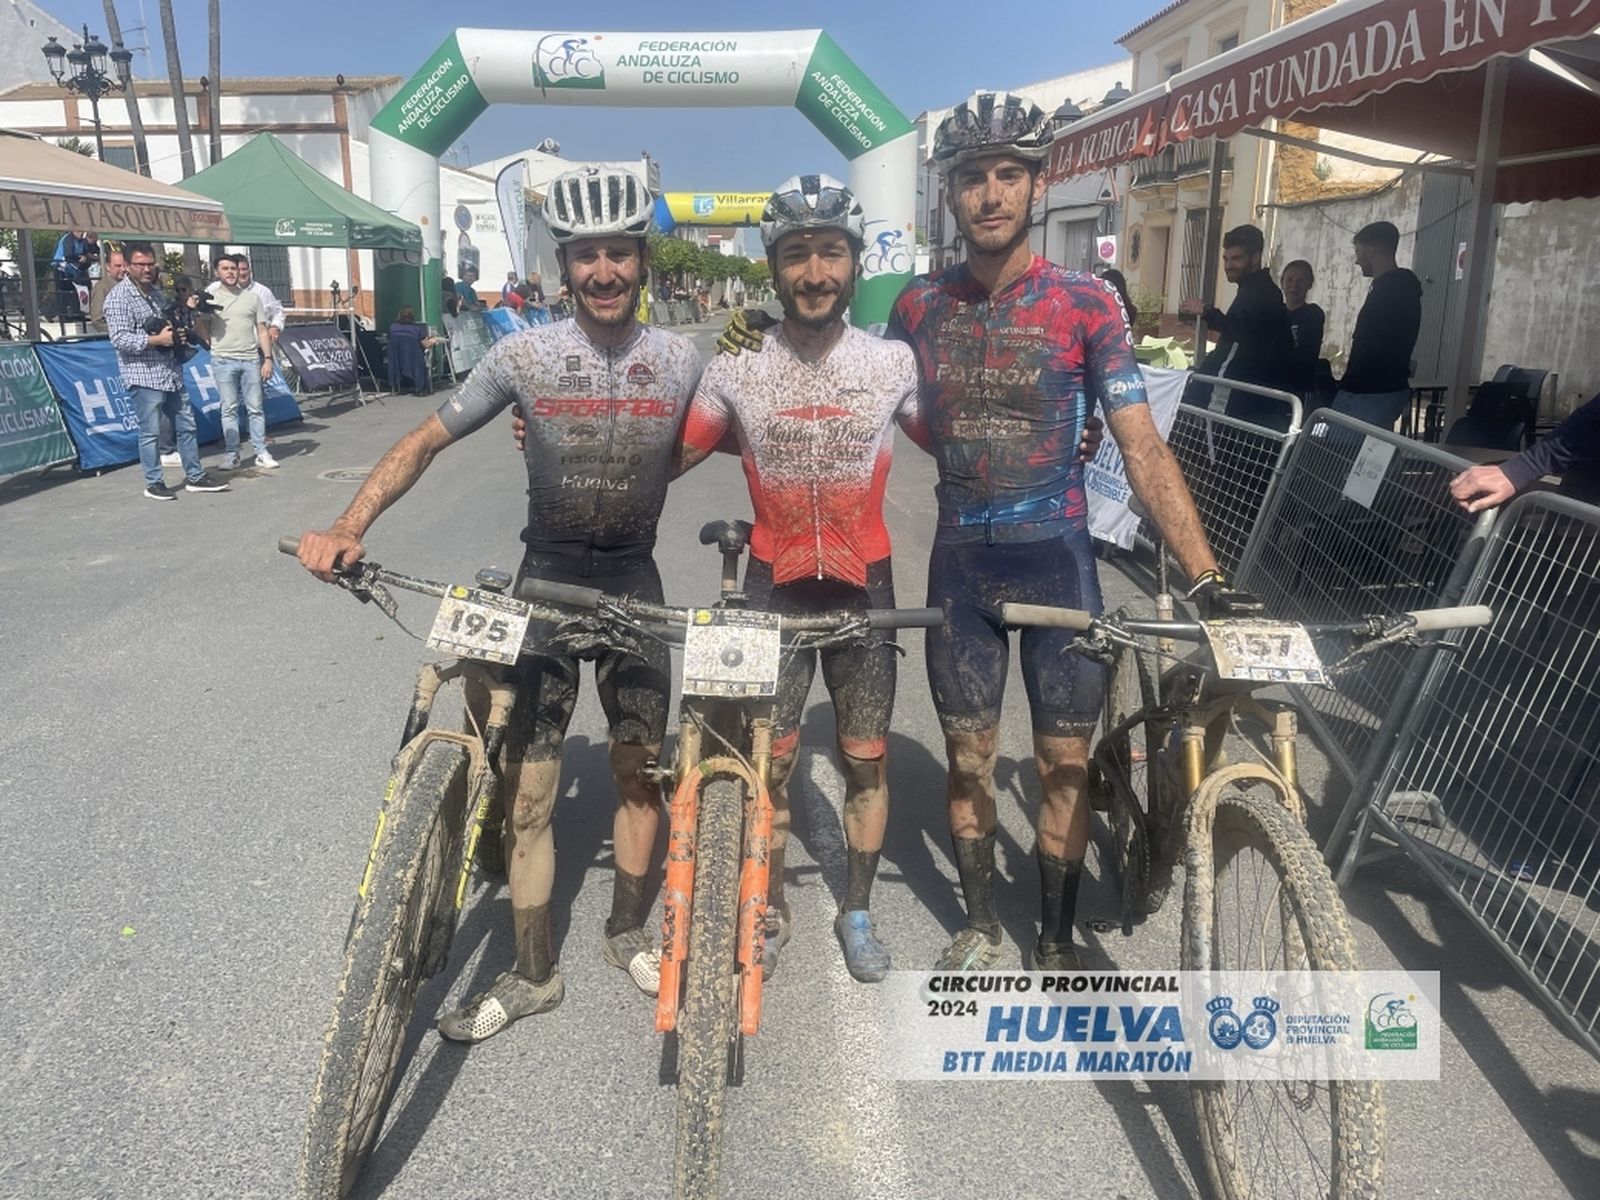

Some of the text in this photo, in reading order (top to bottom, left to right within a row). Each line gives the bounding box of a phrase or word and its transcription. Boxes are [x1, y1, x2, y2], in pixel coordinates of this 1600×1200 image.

[616, 54, 702, 67] ANDALUZA
[638, 40, 738, 52] FEDERACIÓN
[643, 71, 740, 84] DE CICLISMO
[1171, 79, 1239, 133] CASA
[1246, 8, 1426, 116] FUNDADA
[397, 85, 444, 134] ANDALUZA
[417, 74, 469, 129] DE CICLISMO
[811, 71, 860, 121] ANDALUZA
[830, 74, 887, 132] FEDERACIÓN
[817, 92, 872, 149] DE CICLISMO
[1055, 142, 1075, 175] LA
[81, 201, 189, 233] TASQUITA
[115, 397, 135, 416] DE
[450, 610, 509, 642] 195
